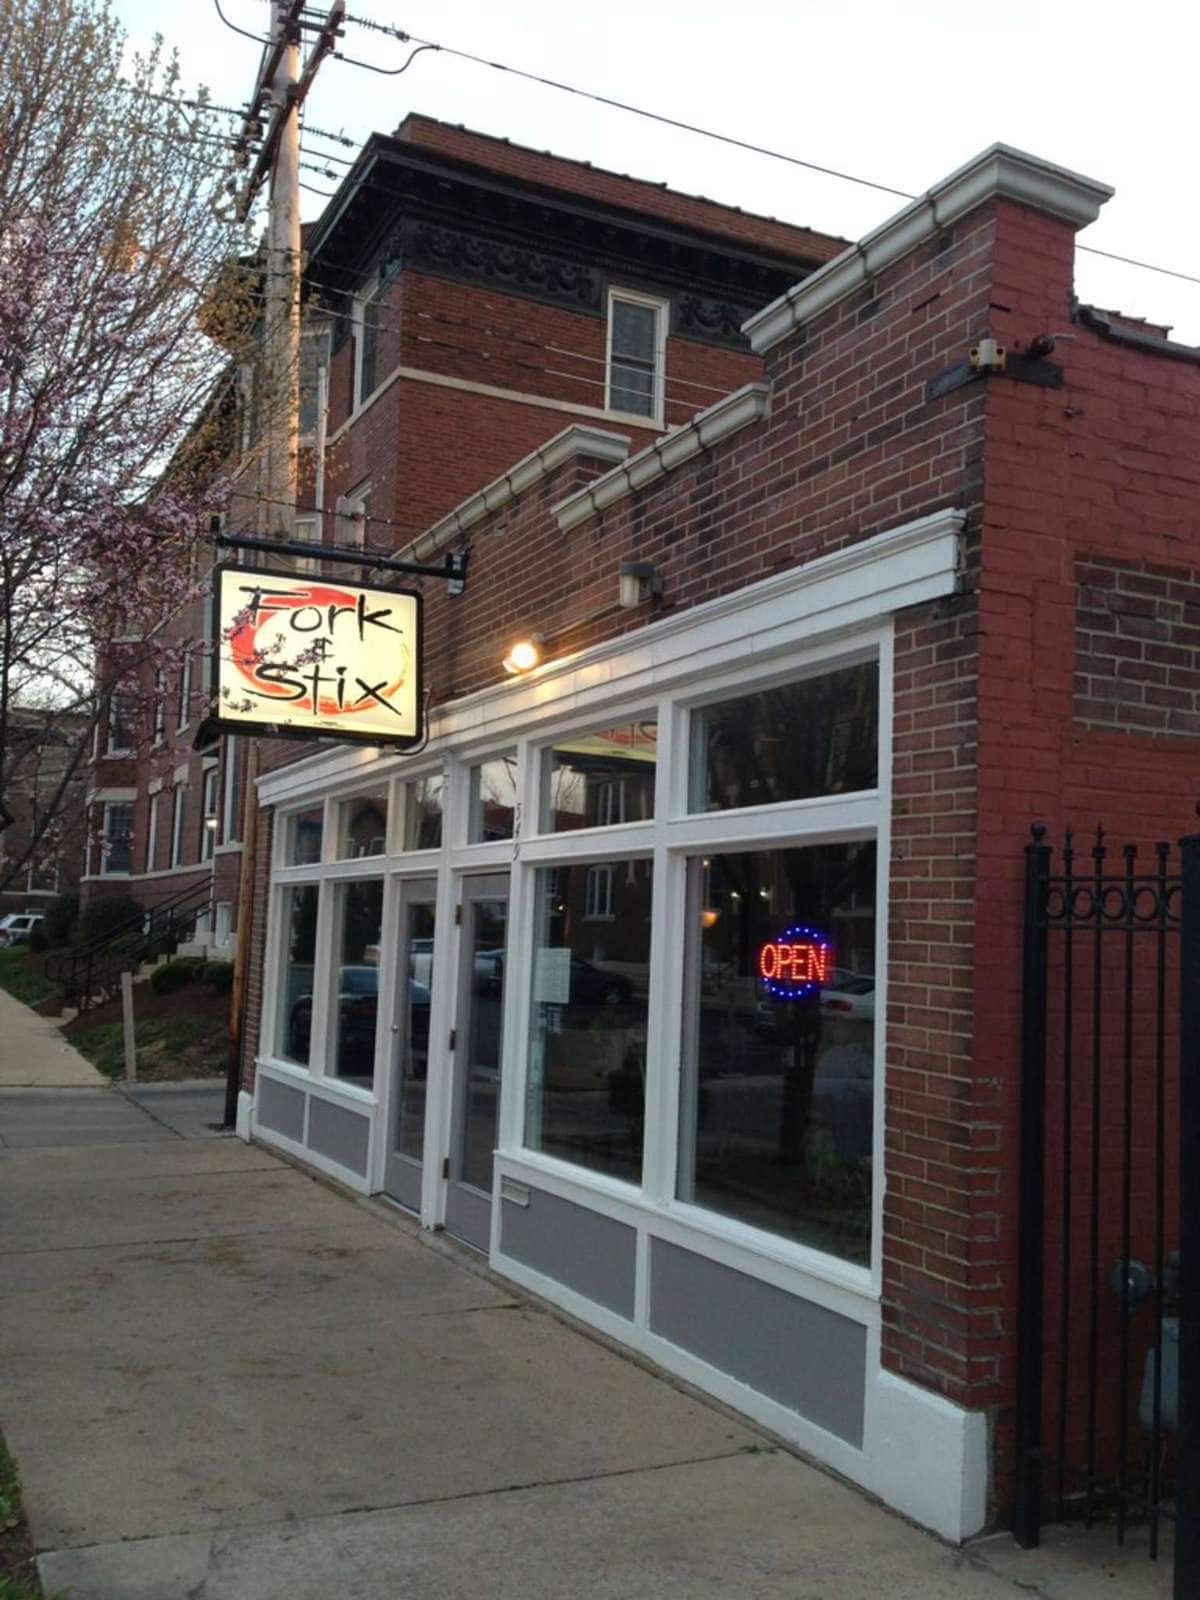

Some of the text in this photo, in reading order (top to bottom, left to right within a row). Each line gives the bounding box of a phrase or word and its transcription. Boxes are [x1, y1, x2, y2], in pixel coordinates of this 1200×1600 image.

[238, 585, 404, 641] Fork
[240, 663, 402, 716] Stix
[760, 943, 825, 981] OPEN
